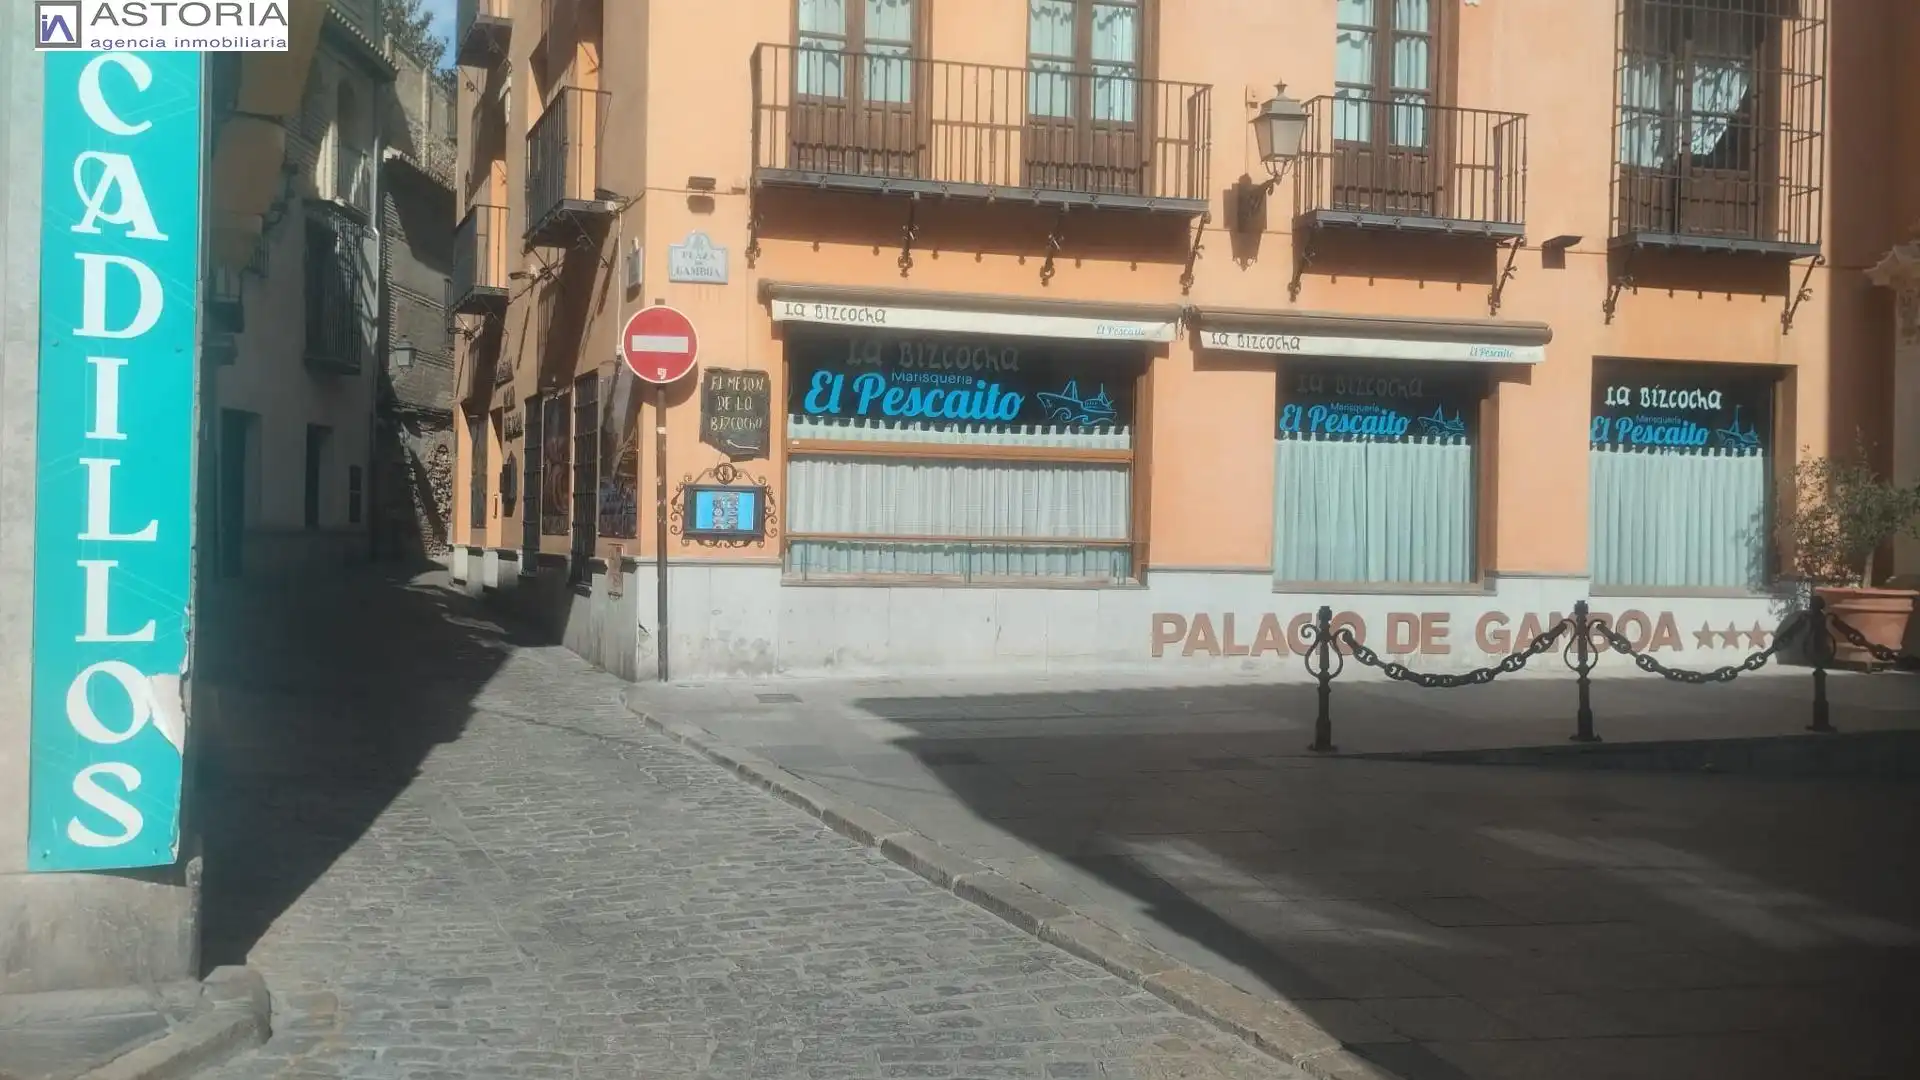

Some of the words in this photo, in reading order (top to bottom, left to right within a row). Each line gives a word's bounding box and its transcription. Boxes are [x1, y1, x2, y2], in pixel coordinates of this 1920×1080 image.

[804, 370, 844, 414] El
[853, 372, 1025, 421] Pescaito
[1279, 403, 1303, 431] El
[1307, 404, 1411, 435] Pescaito
[1590, 415, 1611, 442] El
[1615, 417, 1710, 445] Pescaito
[1386, 612, 1450, 654] DE
